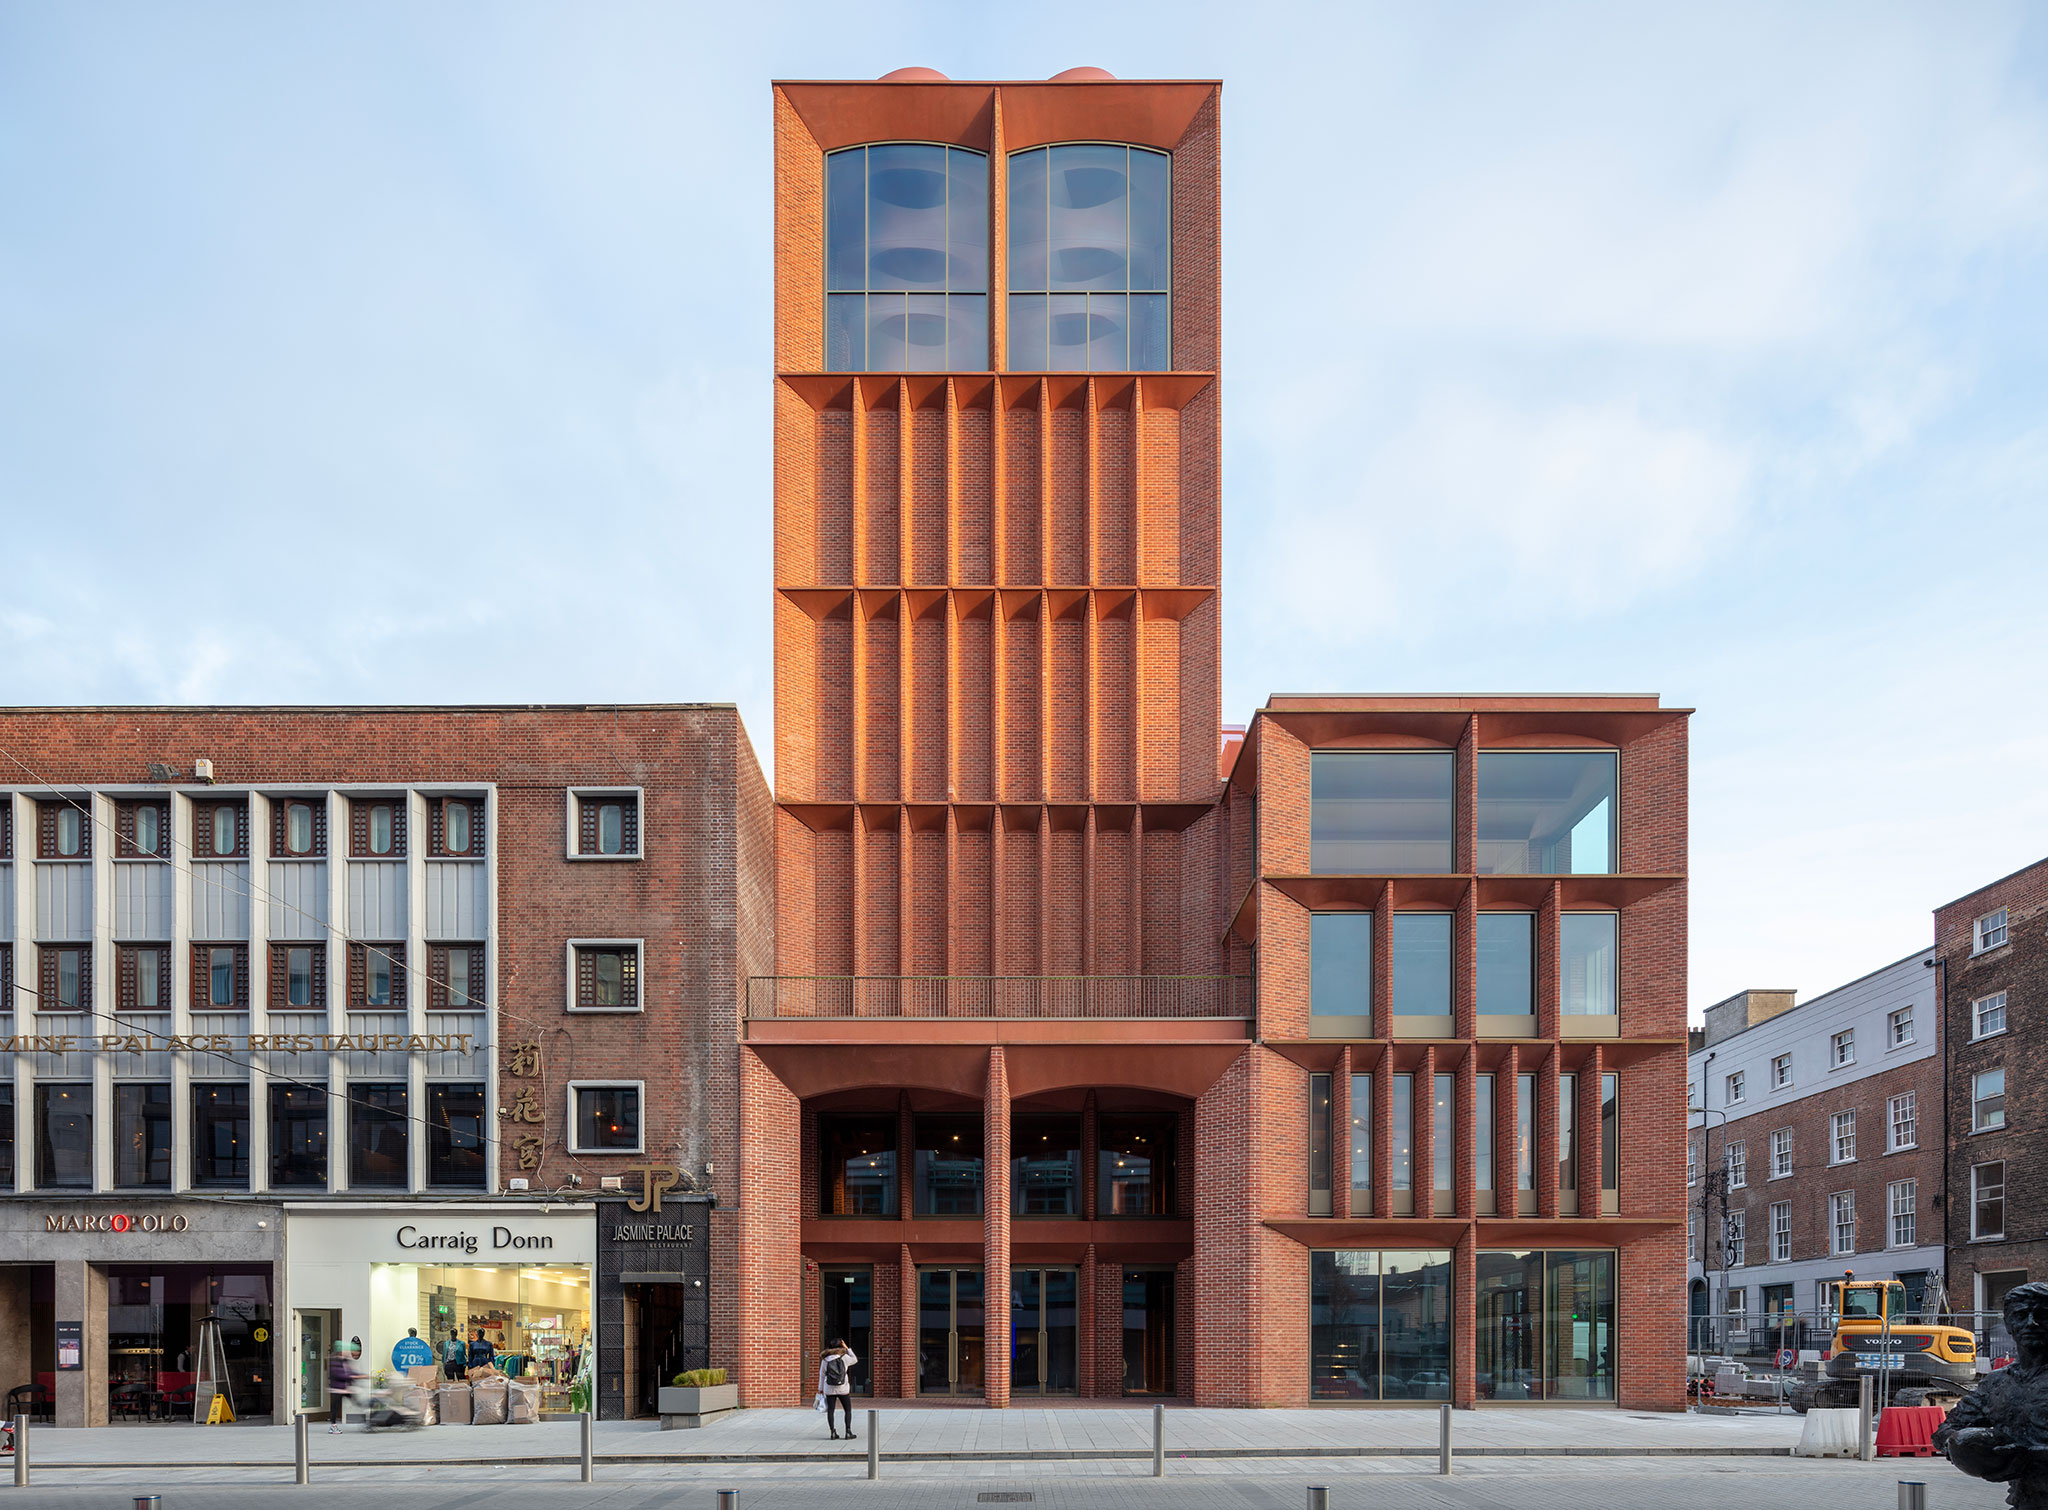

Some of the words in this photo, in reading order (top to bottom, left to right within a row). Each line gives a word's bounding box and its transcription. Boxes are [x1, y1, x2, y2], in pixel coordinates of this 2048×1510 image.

[102, 1034, 232, 1052] PALACE
[247, 1034, 474, 1052] RESTAURANT
[627, 1164, 680, 1213] JP
[396, 1225, 479, 1254] Carraig
[493, 1226, 553, 1249] Donn
[612, 1225, 655, 1241] JASMINE
[656, 1225, 694, 1240] PALACE
